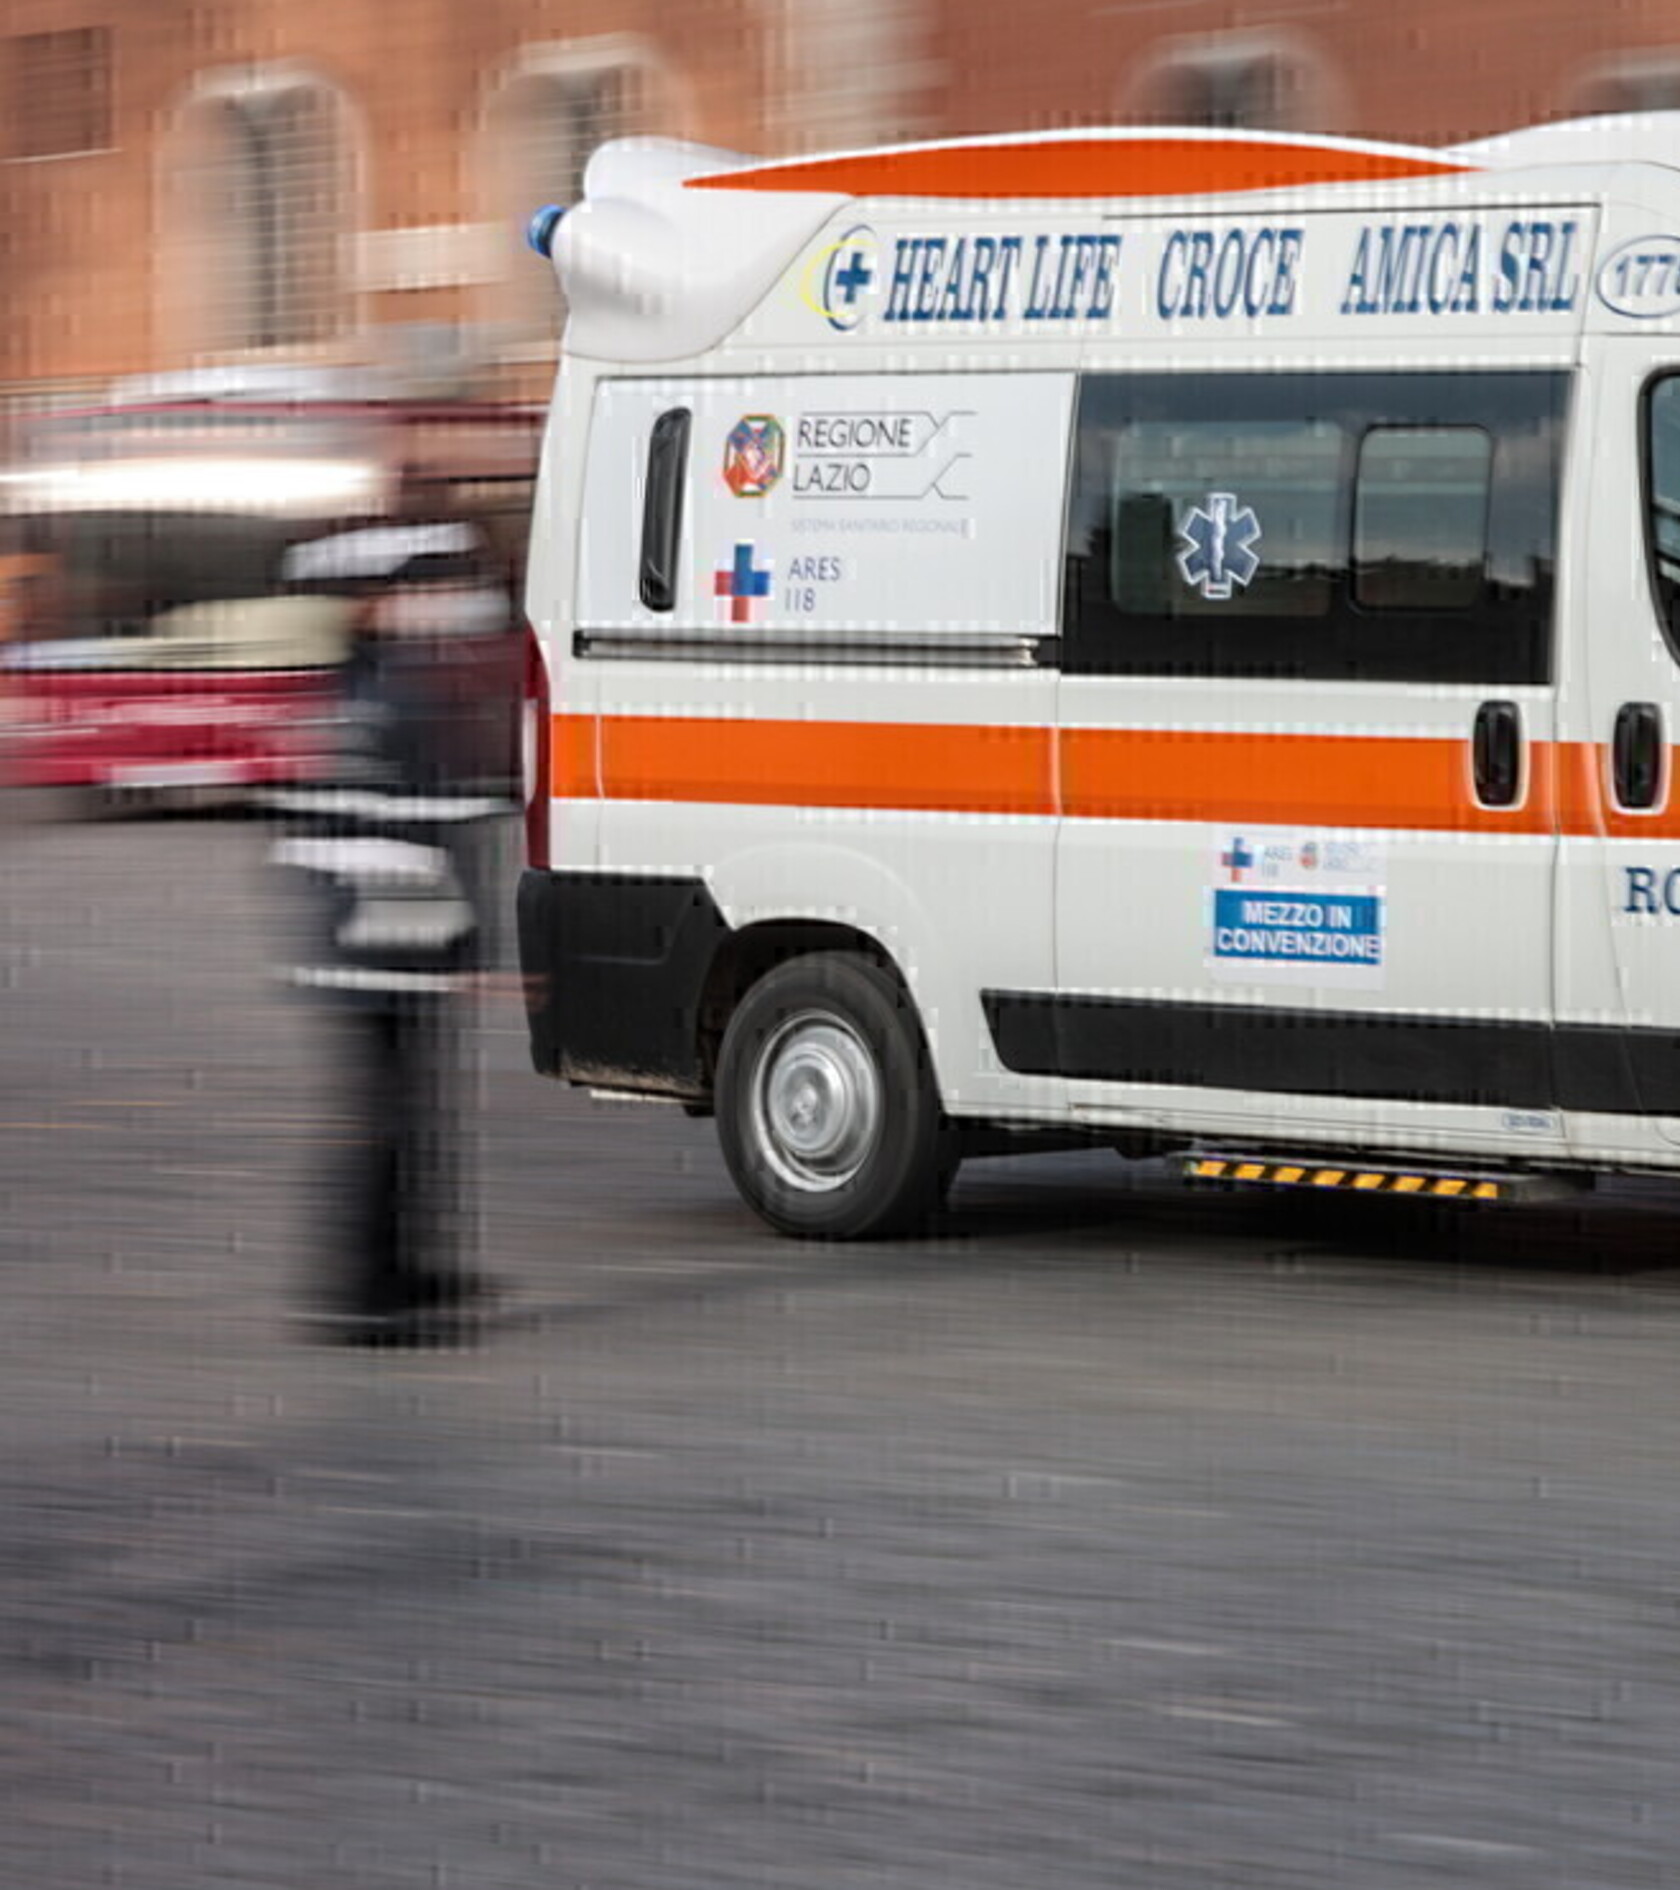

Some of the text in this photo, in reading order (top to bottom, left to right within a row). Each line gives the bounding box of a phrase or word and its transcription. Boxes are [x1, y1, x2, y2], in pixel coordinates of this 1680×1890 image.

[884, 222, 1577, 322] HEART LIFE CROCE AMICA SRL
[797, 419, 913, 448] REGIONE
[793, 463, 872, 492] LAZIO
[788, 556, 840, 581] ARES
[786, 587, 816, 612] 118
[1245, 901, 1353, 928] MEZZO IN
